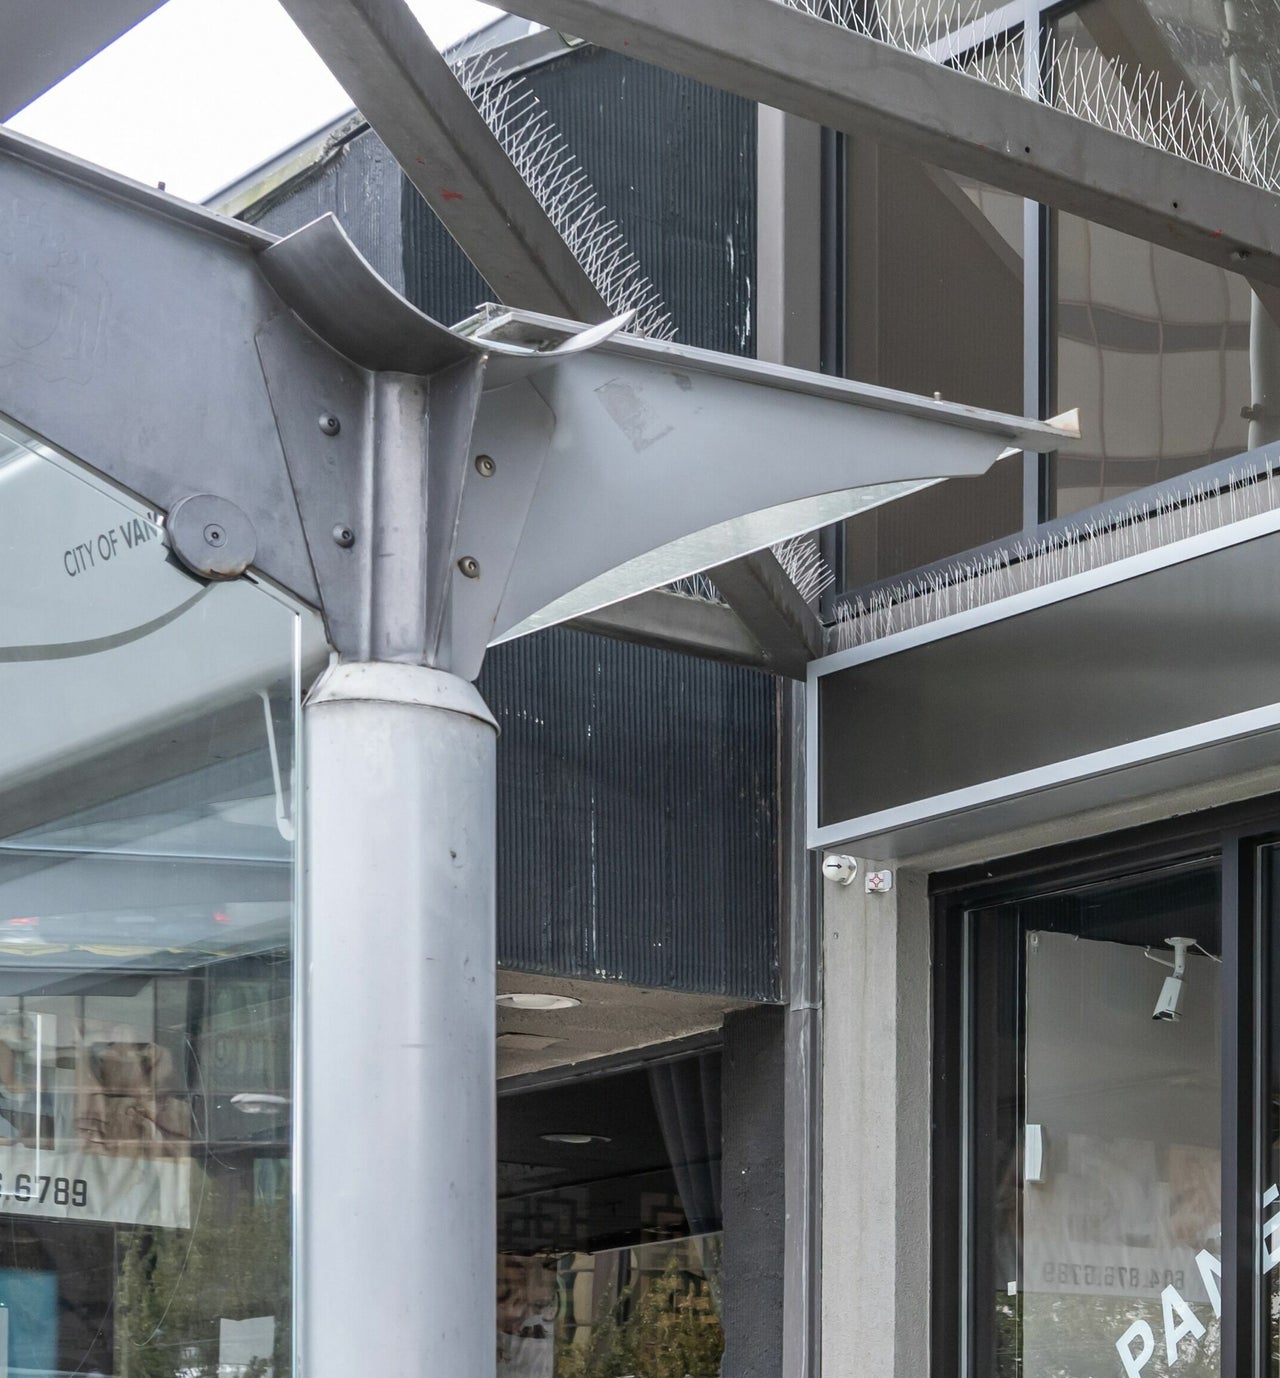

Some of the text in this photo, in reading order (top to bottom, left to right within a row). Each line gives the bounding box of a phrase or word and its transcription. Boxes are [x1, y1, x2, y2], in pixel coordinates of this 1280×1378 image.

[64, 541, 95, 577] CITY
[98, 530, 118, 560] OF
[0, 1172, 87, 1207] .6789
